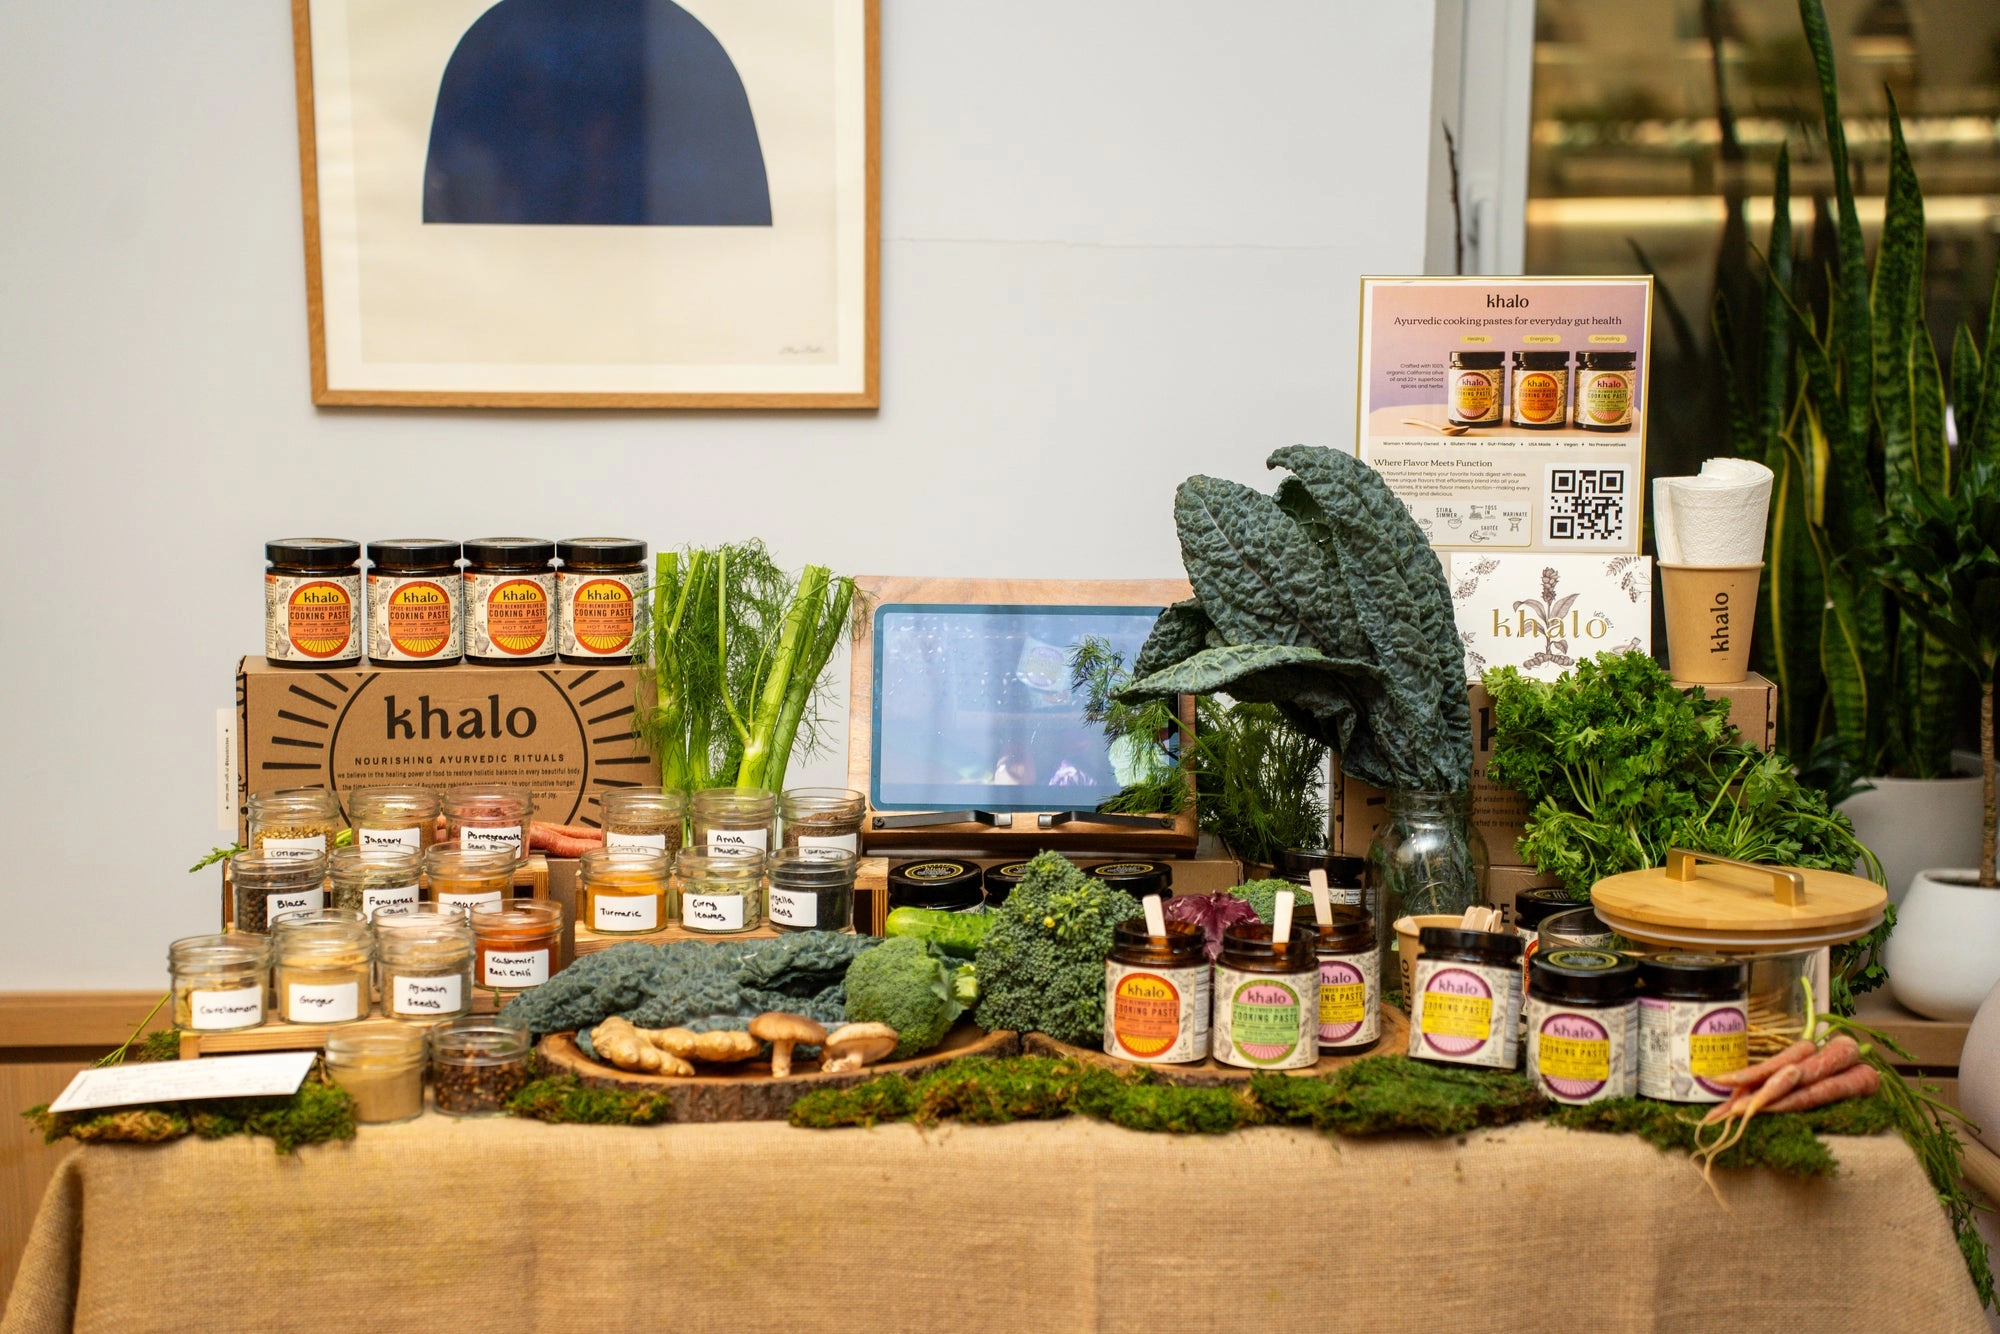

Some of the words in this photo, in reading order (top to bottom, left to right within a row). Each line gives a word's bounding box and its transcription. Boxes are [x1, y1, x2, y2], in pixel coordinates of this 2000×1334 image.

[1487, 294, 1530, 309] khalo
[1393, 316, 1442, 327] Ayurvedic
[1443, 316, 1482, 328] cooking
[1483, 317, 1513, 327] pastes
[1514, 316, 1529, 326] for
[1530, 316, 1573, 327] everyday
[1574, 317, 1591, 327] gut
[1592, 316, 1623, 325] health
[1462, 378, 1484, 386] khalo
[1527, 380, 1550, 388] khalo
[1597, 380, 1621, 388] khalo
[1374, 459, 1402, 468] Where
[1403, 459, 1429, 468] Flavor
[1431, 459, 1454, 468] Meets
[1456, 459, 1493, 468] Function
[303, 591, 339, 604] khalo
[403, 591, 438, 604] khalo
[502, 589, 537, 601] khalo
[586, 589, 622, 601] khalo
[290, 611, 326, 620] COOKING
[328, 610, 350, 619] PASTE
[390, 611, 425, 620] COOKING
[427, 610, 449, 620] PASTE
[489, 609, 523, 618] COOKING
[526, 608, 547, 617] PASTE
[574, 608, 607, 617] COOKING
[610, 607, 632, 616] PASTE
[1491, 608, 1608, 639] khalo
[1710, 592, 1730, 654] khalo
[384, 694, 538, 740] khalo
[354, 756, 433, 766] NOURISHING
[440, 754, 507, 765] AYURVEDIC
[513, 753, 565, 764] RITUALS
[385, 771, 406, 779] healing
[408, 771, 424, 779] power
[495, 768, 518, 776] balance
[526, 769, 541, 777] every
[541, 768, 566, 776] beautiful
[342, 783, 352, 791] the
[556, 780, 576, 788] hunger.
[548, 792, 557, 800] joy.
[716, 834, 745, 845] Amla
[277, 899, 308, 909] Black
[692, 899, 718, 912] Curry
[600, 907, 642, 919] Turmeric
[694, 911, 726, 923] leaves
[490, 955, 535, 965] Kashmiri
[1128, 983, 1165, 999] khalo
[1438, 978, 1478, 996] khalo
[299, 995, 335, 1008] Ginger
[1247, 990, 1287, 1005] khalo
[1340, 992, 1364, 1001] PASTE
[1115, 1003, 1148, 1017] COOKING
[1151, 1008, 1178, 1018] PASTE
[1424, 1001, 1459, 1014] COOKING
[1463, 1005, 1490, 1017] PASTE
[1233, 1010, 1269, 1022] COOKING
[1273, 1013, 1298, 1023] PASTE
[1553, 1023, 1594, 1040] khalo
[1709, 1020, 1742, 1034] khalo
